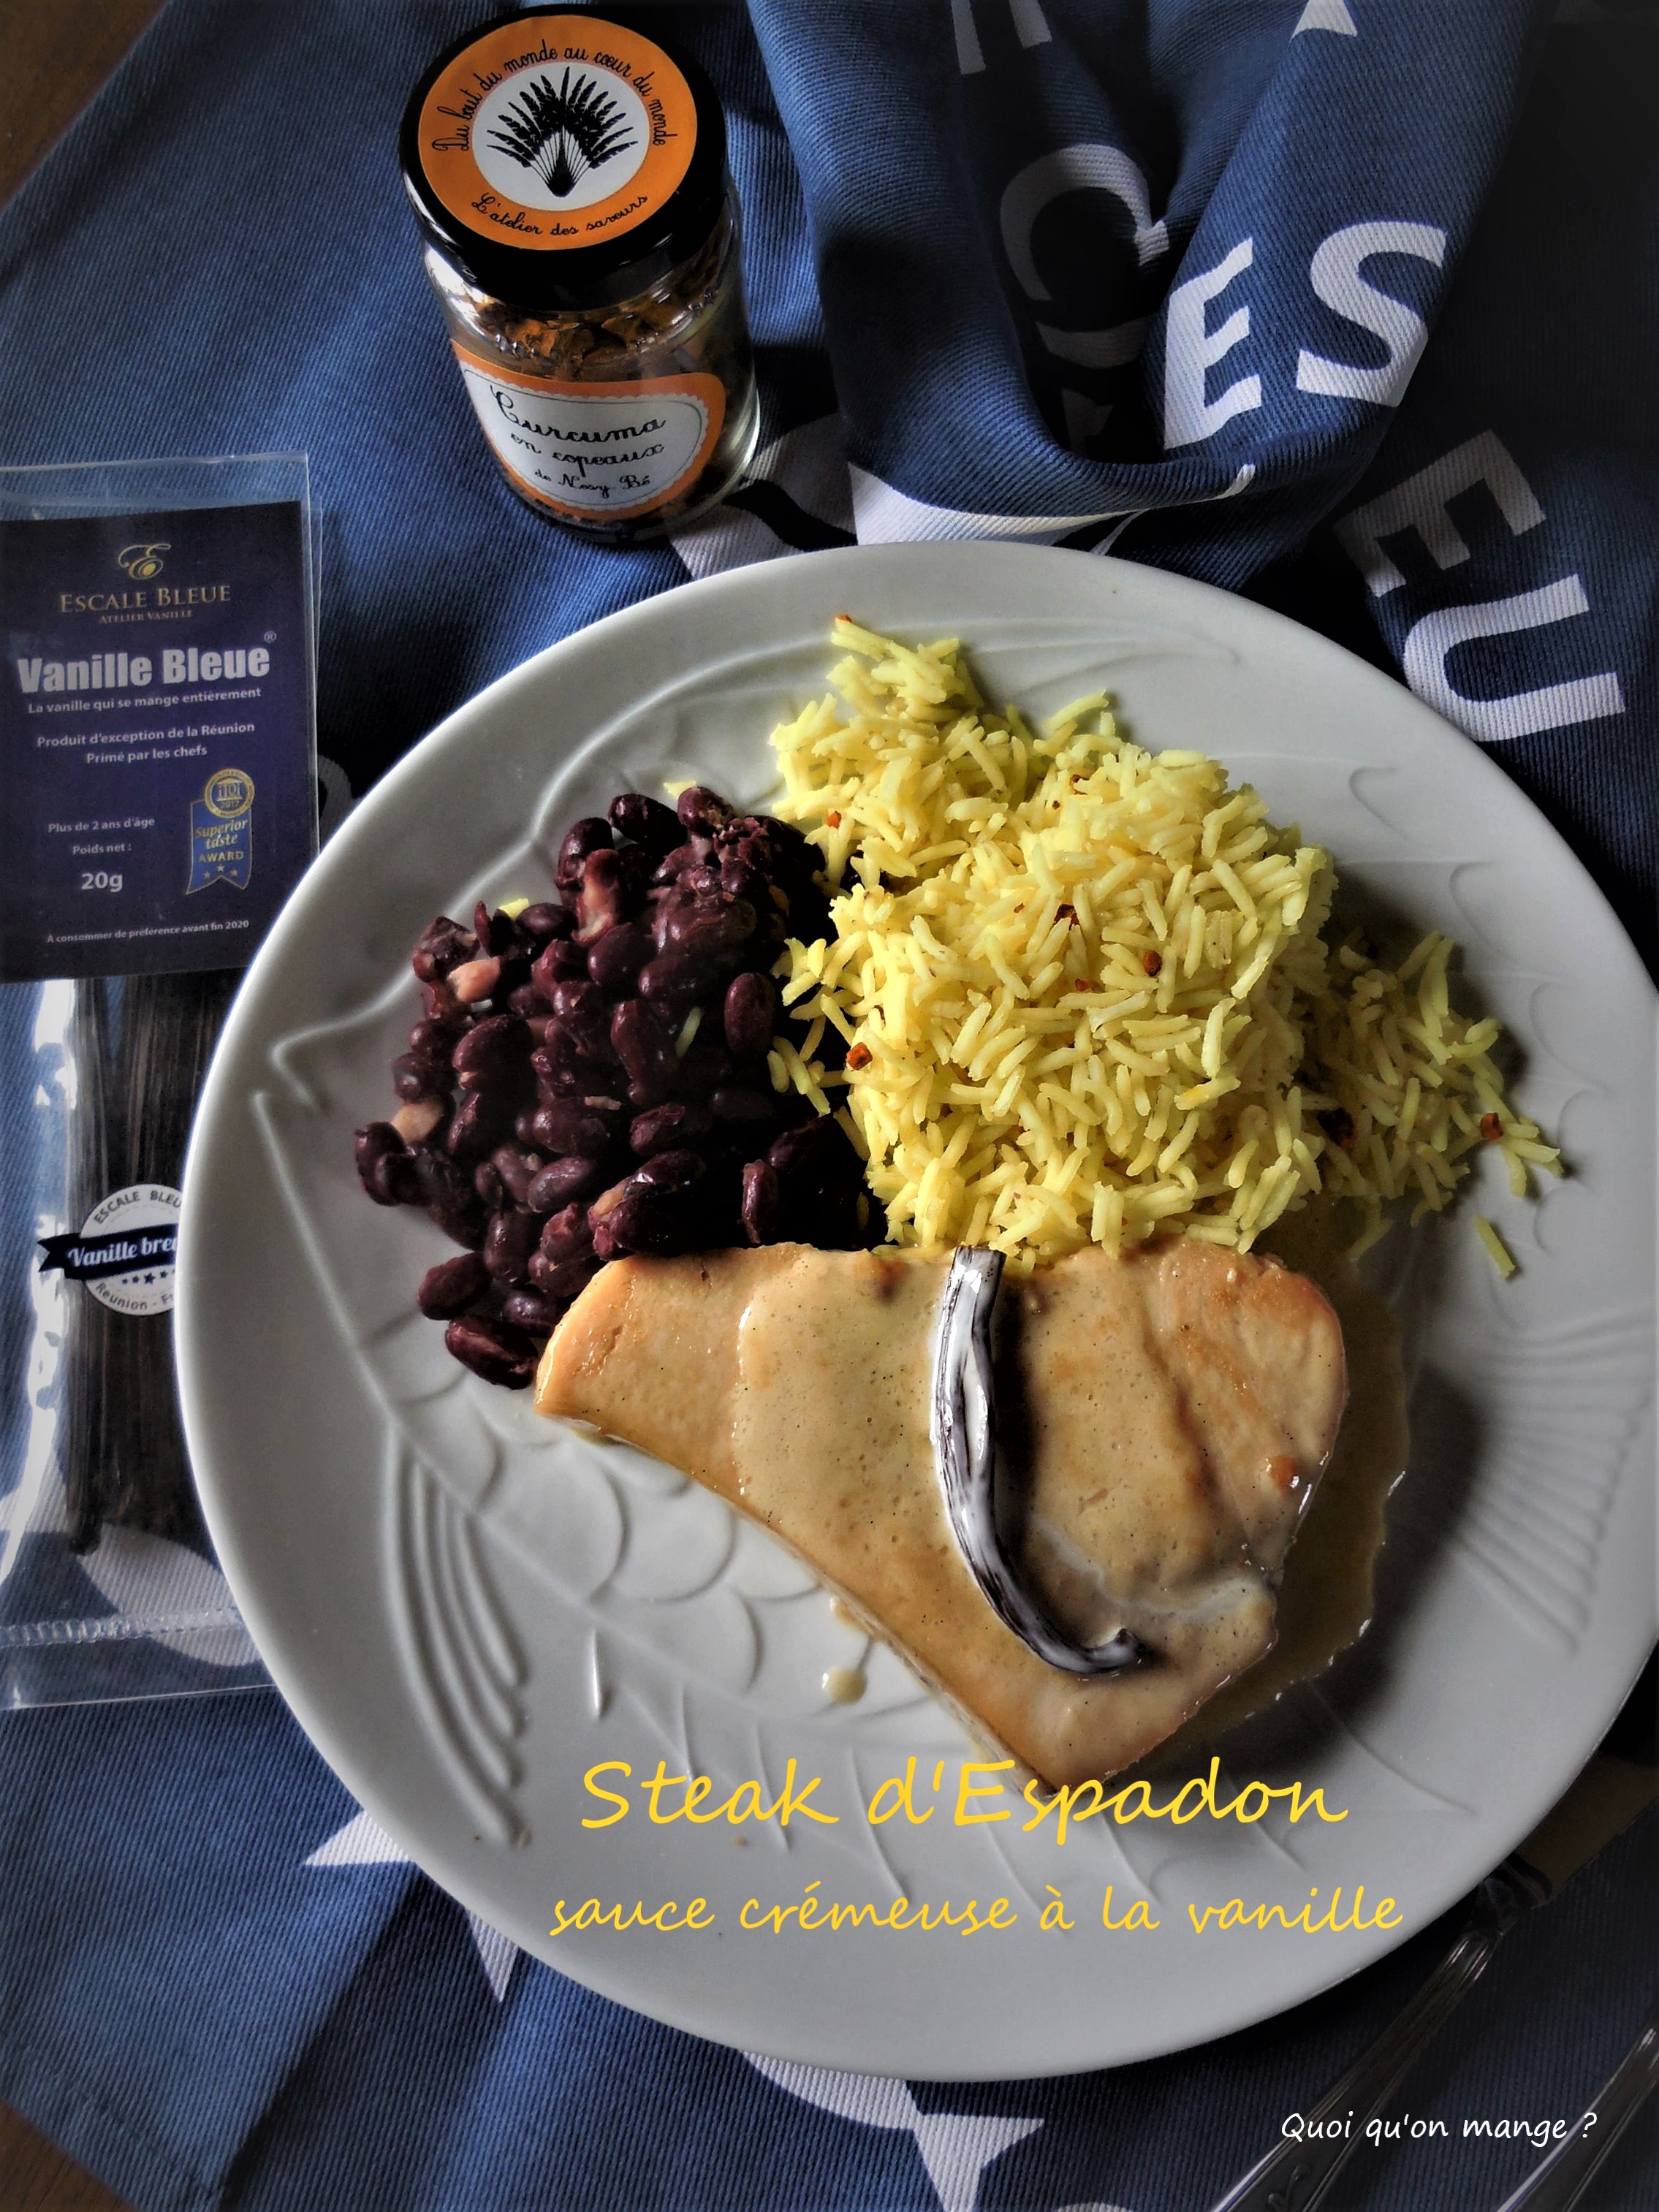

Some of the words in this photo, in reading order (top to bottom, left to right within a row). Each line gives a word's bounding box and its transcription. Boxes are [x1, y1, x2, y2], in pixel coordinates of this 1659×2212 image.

[504, 39, 558, 72] monde
[563, 47, 589, 61] au
[473, 72, 503, 91] du
[633, 71, 656, 97] du
[437, 88, 482, 121] bout
[648, 99, 678, 146] monde
[432, 125, 470, 151] Du
[471, 192, 544, 235] L'atelier
[550, 223, 580, 236] des
[585, 195, 648, 231] saveurs
[490, 384, 667, 443] Curcuma
[510, 433, 542, 454] en
[552, 444, 665, 478] copeaux
[534, 468, 552, 482] de
[60, 590, 147, 614] ESCALE
[156, 585, 232, 607] BLEUE
[99, 613, 145, 625] ATELIER
[147, 609, 194, 621] VANILLE
[17, 653, 153, 693] Vanille
[28, 703, 44, 714] La
[47, 699, 91, 713] vanille
[93, 699, 115, 712] qui
[118, 699, 132, 708] se
[134, 696, 180, 710] mange
[182, 688, 262, 703] entièrement
[37, 734, 87, 748] Produit
[89, 730, 164, 746] d'exception
[167, 728, 183, 739] de
[186, 726, 199, 738] la
[201, 722, 255, 737] Réunion
[86, 751, 126, 764] Primé
[127, 751, 148, 764] par
[152, 748, 171, 760] les
[173, 744, 208, 757] chefs
[48, 823, 72, 833] Plus
[75, 821, 90, 832] de
[91, 820, 99, 830] 2
[101, 820, 121, 830] ans
[72, 843, 105, 855] Poids
[106, 843, 126, 853] net
[198, 851, 245, 863] AWARD
[80, 871, 124, 893] 20g
[56, 931, 113, 943] consommer
[114, 929, 127, 938] de
[128, 926, 181, 940] préférence
[182, 922, 209, 933] avant
[210, 921, 224, 930] fin
[225, 919, 250, 930] 2020
[93, 1190, 141, 1225] ESCALE
[67, 1240, 139, 1268] Vanille
